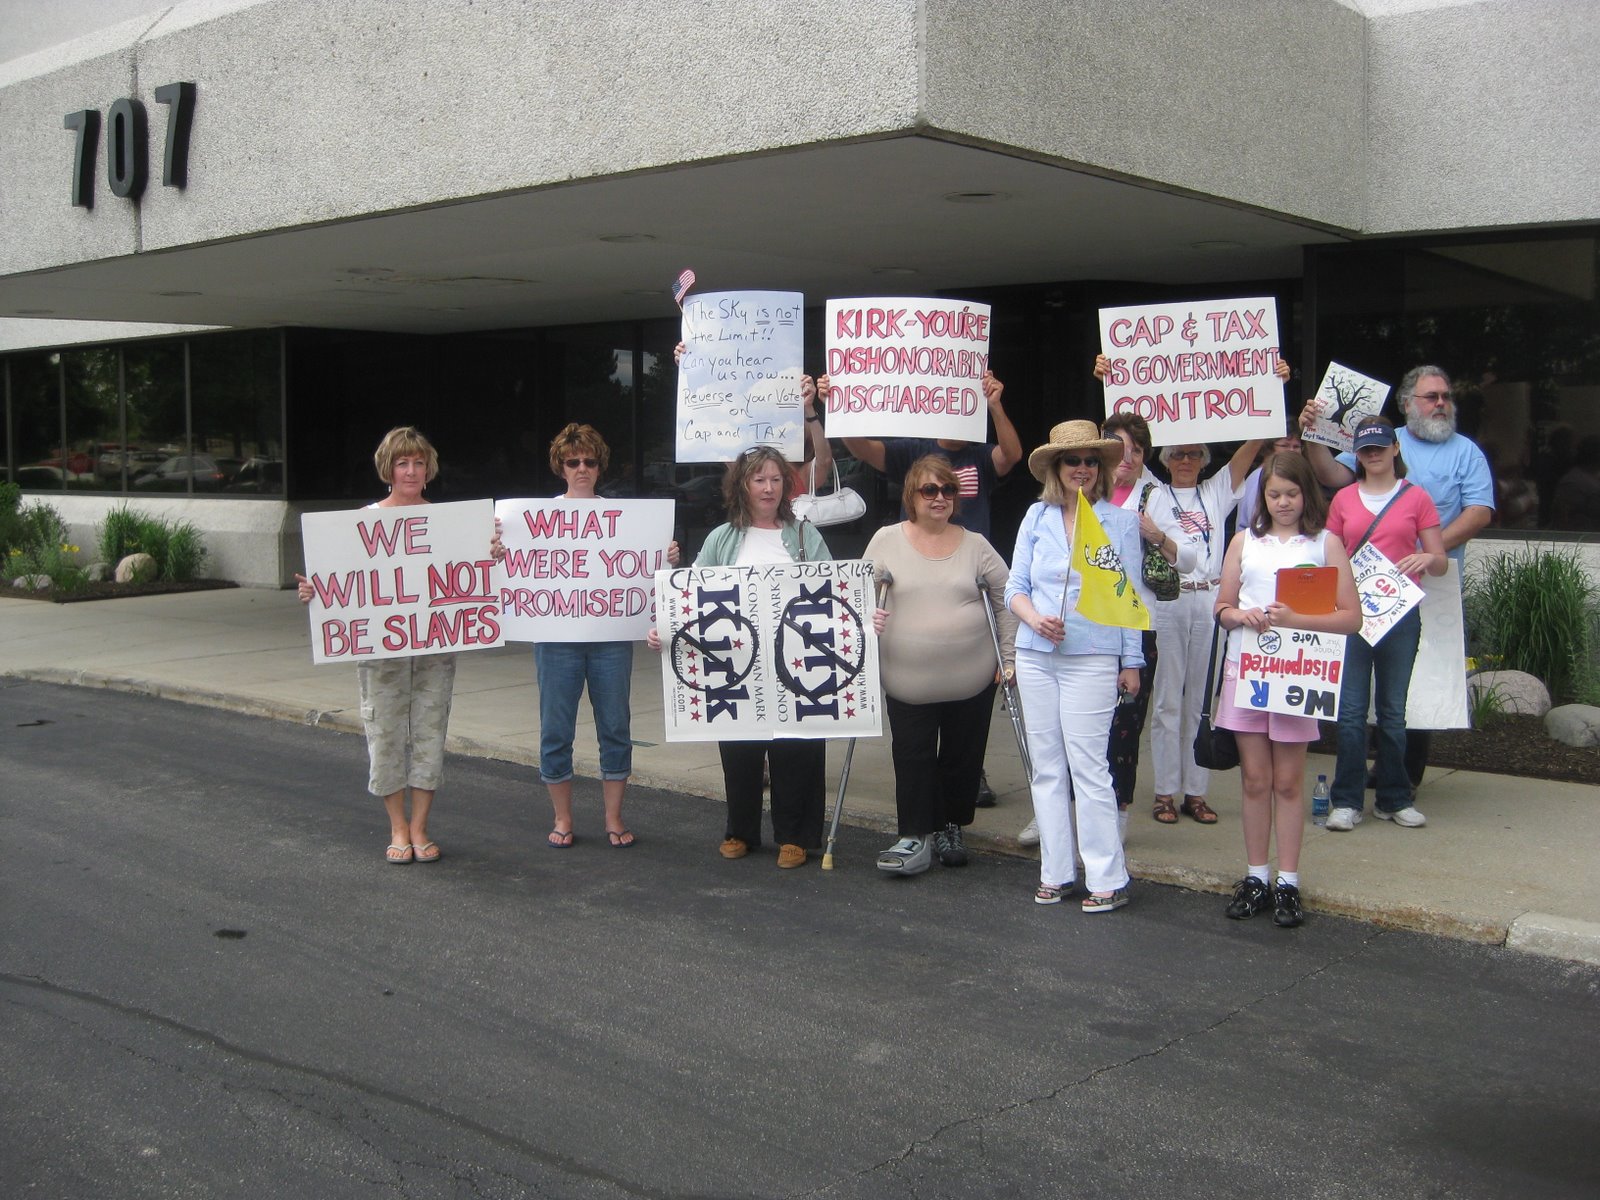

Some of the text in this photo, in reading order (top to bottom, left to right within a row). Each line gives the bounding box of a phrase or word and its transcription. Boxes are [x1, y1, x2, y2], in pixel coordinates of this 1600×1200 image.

[64, 82, 196, 209] 707
[687, 300, 715, 320] The
[755, 306, 770, 318] is
[775, 305, 800, 318] not
[692, 330, 714, 344] the
[1109, 308, 1269, 348] CAP & TAX
[683, 348, 773, 377] Can you hear
[718, 370, 737, 381] us
[828, 346, 989, 380] DISHONORABLY
[1105, 346, 1280, 387] IS GOVERNMENT
[683, 388, 733, 404] Reverse
[743, 393, 772, 413] your
[729, 405, 753, 418] on
[828, 384, 978, 416] DISCHARGED
[1113, 386, 1272, 423] CONTROL
[683, 420, 712, 442] Cap
[717, 427, 741, 439] and
[1358, 427, 1383, 438] SEATTLE
[356, 517, 432, 559] WE
[523, 509, 623, 539] WHAT
[504, 548, 662, 579] WERE YOU
[669, 567, 716, 591] CAP
[790, 562, 833, 579] JOB
[1388, 568, 1411, 588] afford
[311, 560, 498, 610] WILL NOT
[1375, 578, 1397, 597] CAP
[770, 583, 781, 621] MARK
[1360, 592, 1380, 613] Trade
[322, 605, 501, 658] BE SLAVES
[1291, 631, 1320, 646] Vote
[697, 583, 750, 723] Kirk
[788, 580, 839, 722] Kirk
[1240, 648, 1341, 684] Disapointed
[754, 686, 766, 722] MARK
[1249, 680, 1335, 717] We R
